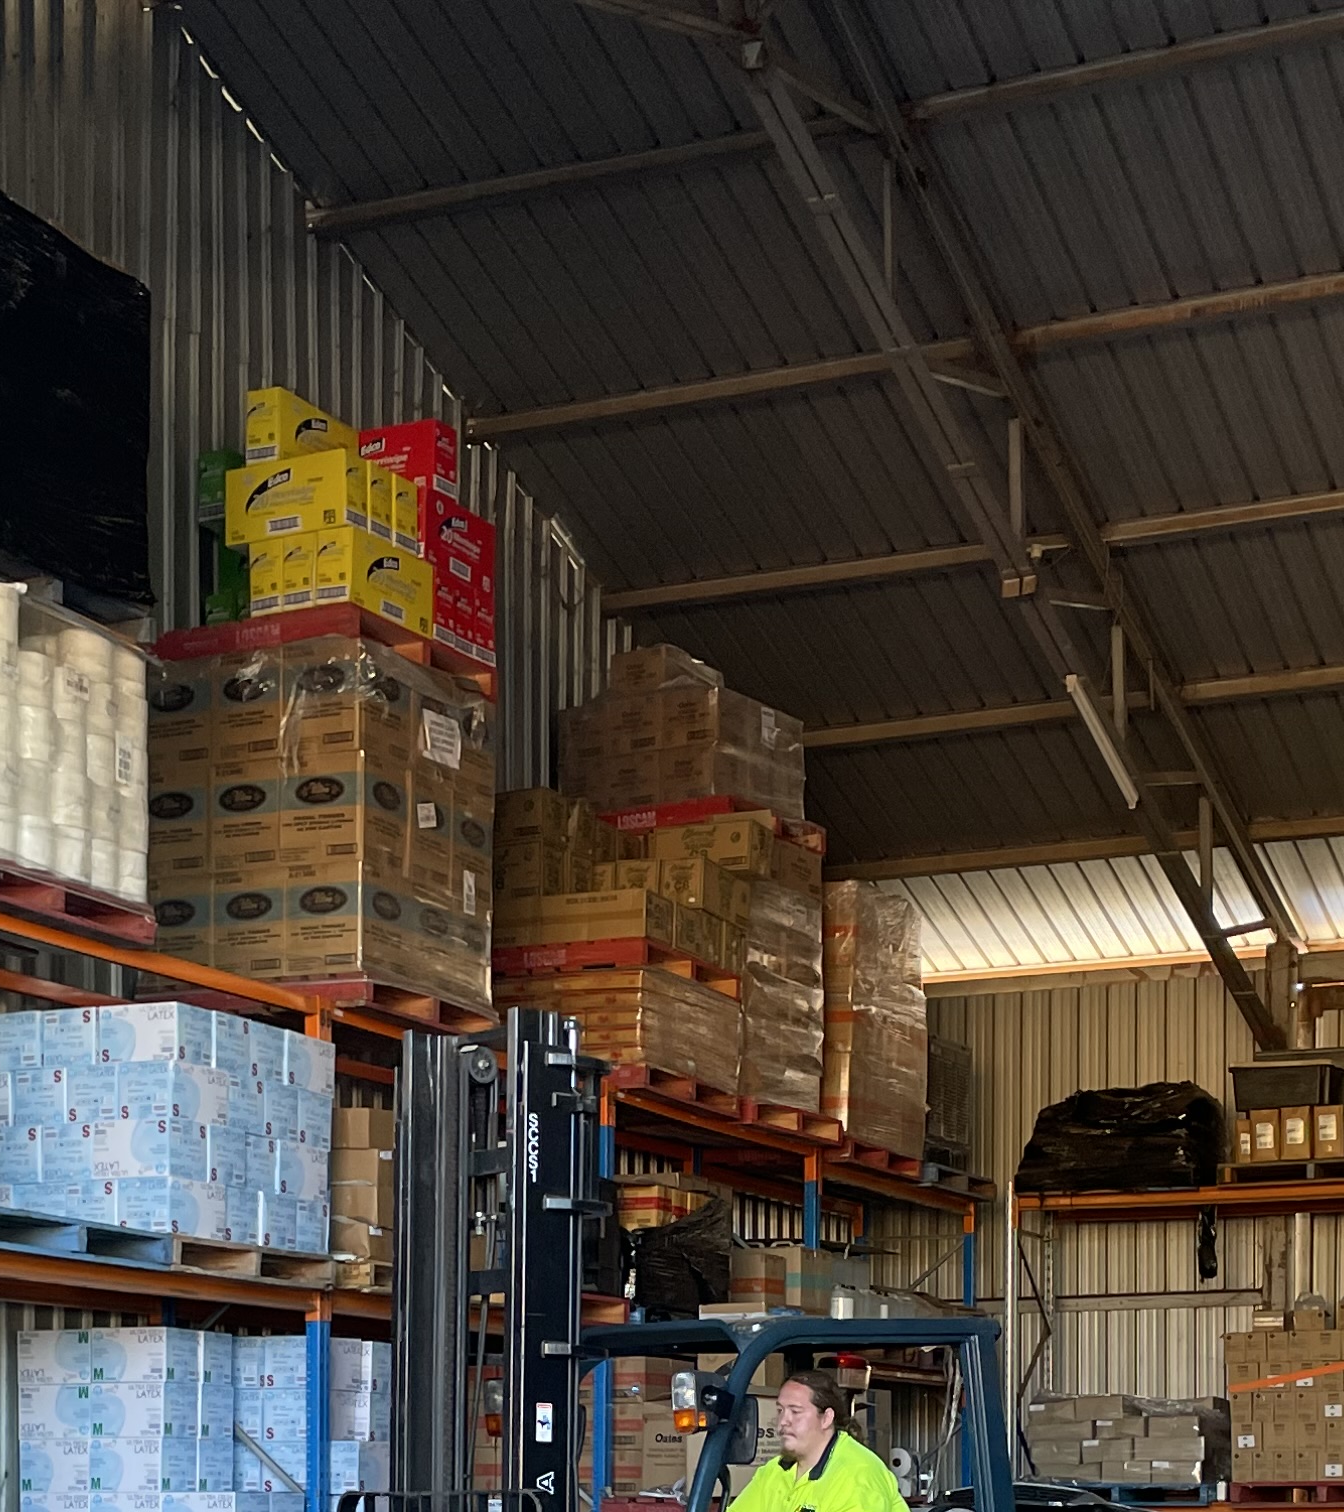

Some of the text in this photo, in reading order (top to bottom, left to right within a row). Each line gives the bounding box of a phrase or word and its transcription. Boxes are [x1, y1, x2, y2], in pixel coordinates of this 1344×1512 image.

[268, 469, 290, 488] Edco
[617, 811, 656, 829] LOSCAM
[82, 1010, 91, 1023] S
[147, 1009, 175, 1021] LATEX
[53, 1069, 62, 1083] S
[528, 1112, 539, 1183] SCCS1
[138, 1334, 165, 1344] LATEX
[93, 1367, 103, 1380] M
[136, 1389, 161, 1399] LATEX
[64, 1445, 89, 1455] LATEX
[134, 1444, 159, 1454] LATEX
[22, 1479, 32, 1491] M
[64, 1500, 89, 1509] LATEX
[135, 1500, 159, 1509] LATEX
[208, 1499, 233, 1509] LATEX
